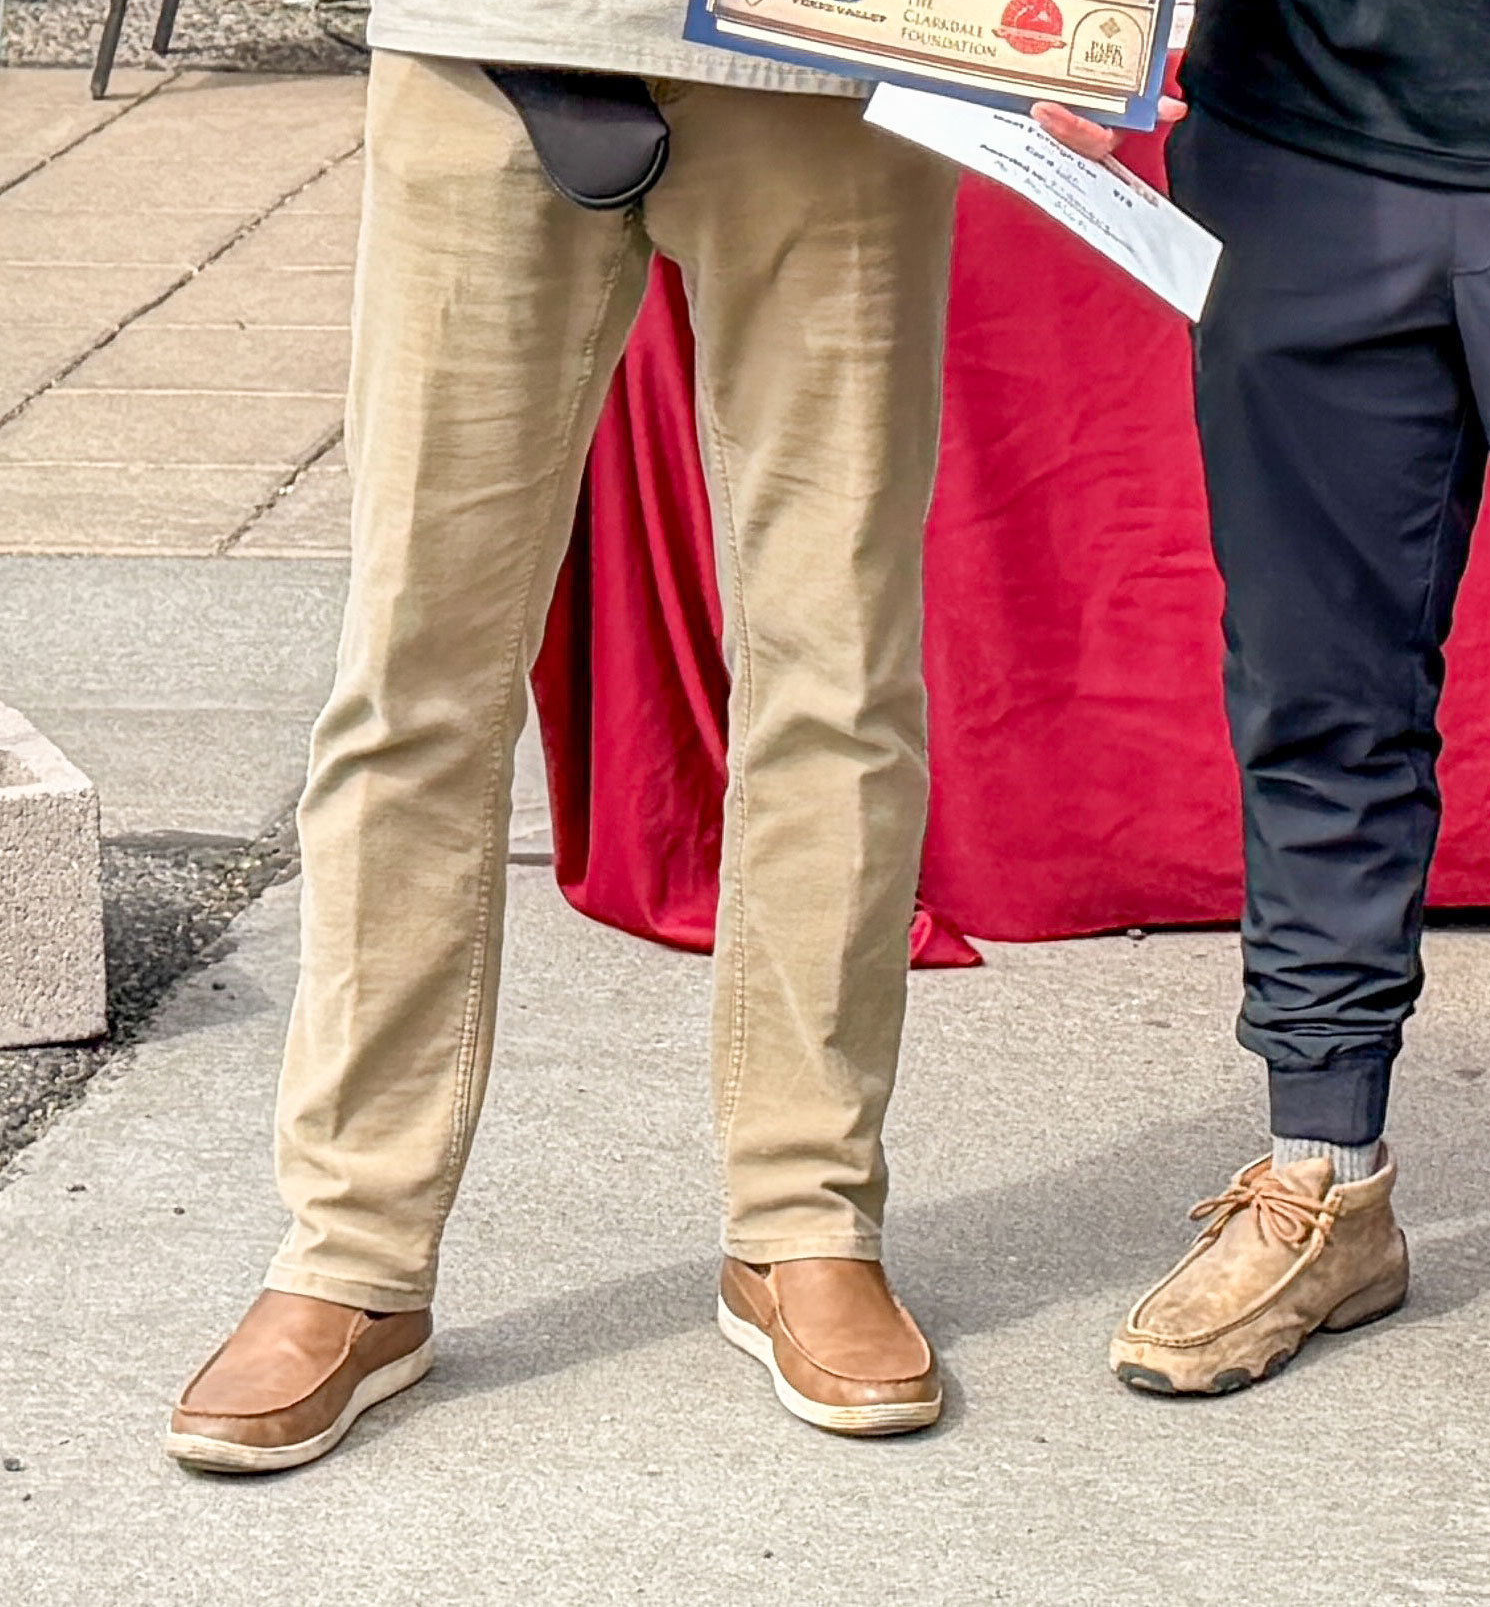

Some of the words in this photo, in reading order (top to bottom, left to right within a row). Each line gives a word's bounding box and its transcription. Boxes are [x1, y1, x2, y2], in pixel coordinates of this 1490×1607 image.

[903, 9, 983, 39] CLARKDALE
[901, 27, 997, 58] FOUNDATION
[1090, 40, 1123, 57] PARK
[1085, 51, 1124, 68] HOTEL
